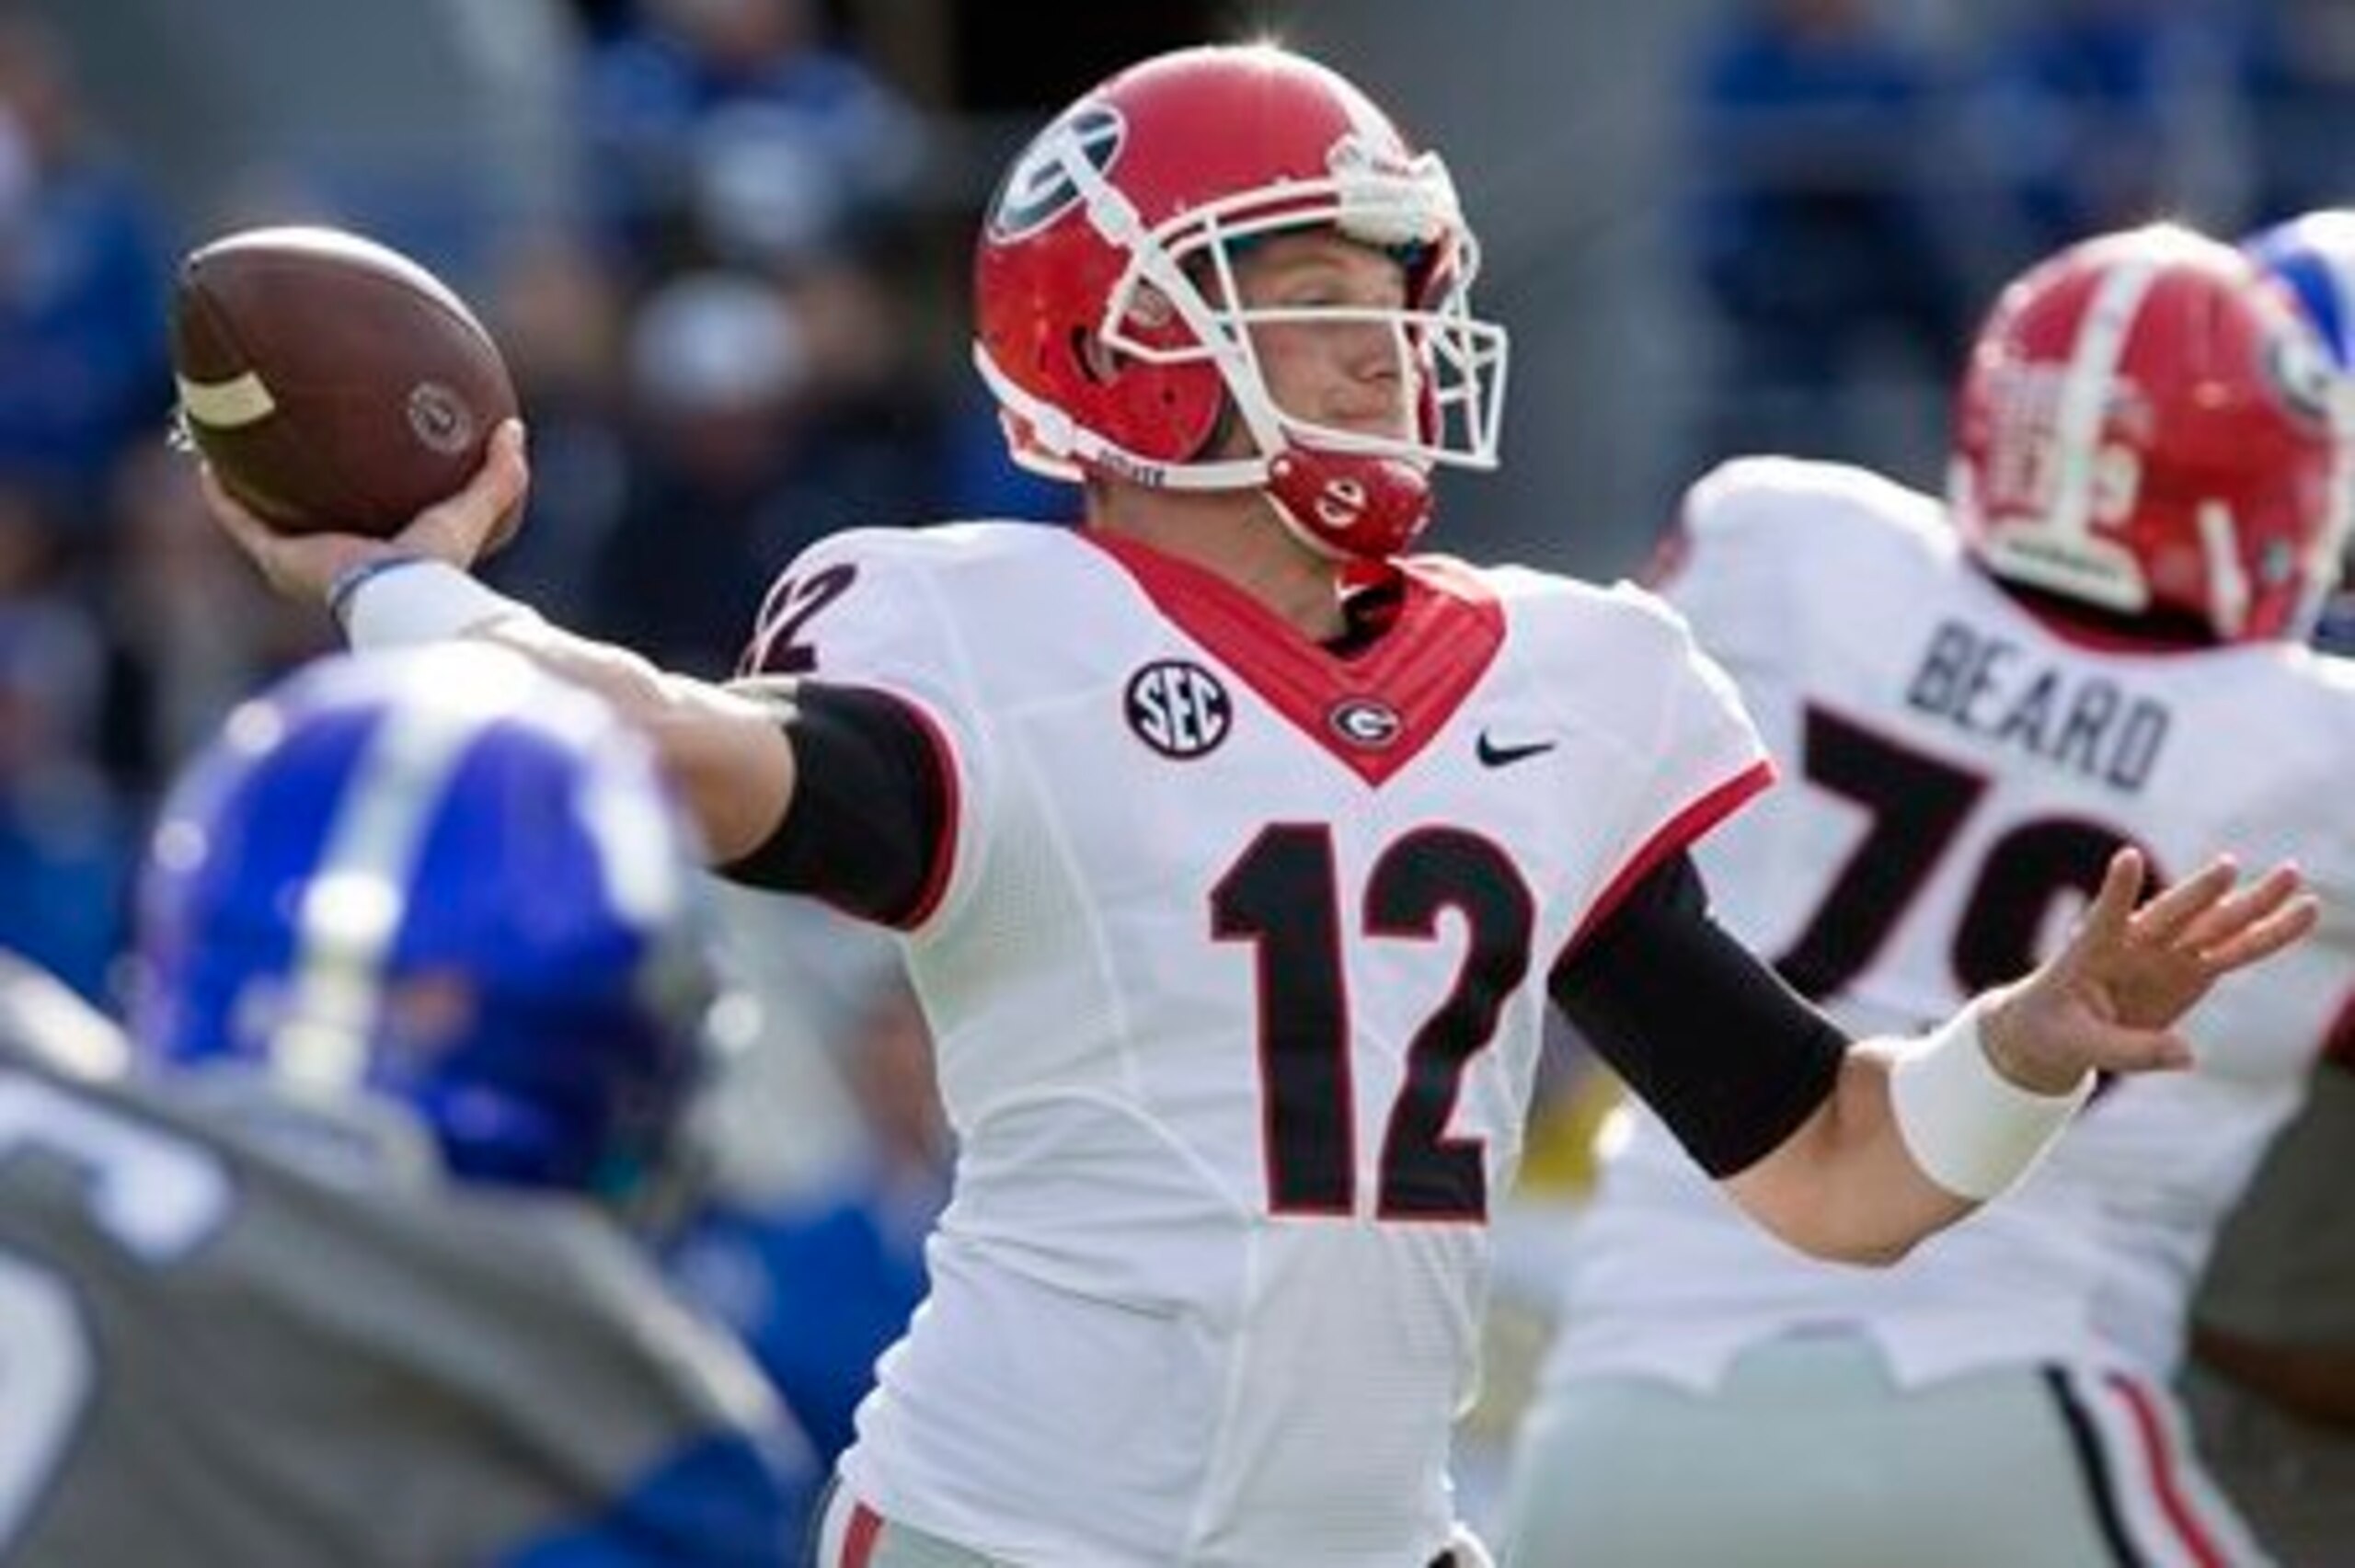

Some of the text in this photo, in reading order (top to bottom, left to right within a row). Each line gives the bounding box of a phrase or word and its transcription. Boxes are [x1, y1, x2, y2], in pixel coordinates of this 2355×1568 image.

[1132, 667, 1225, 753] SEC
[1907, 622, 2172, 793] BEARD
[1209, 821, 1538, 1223] 12
